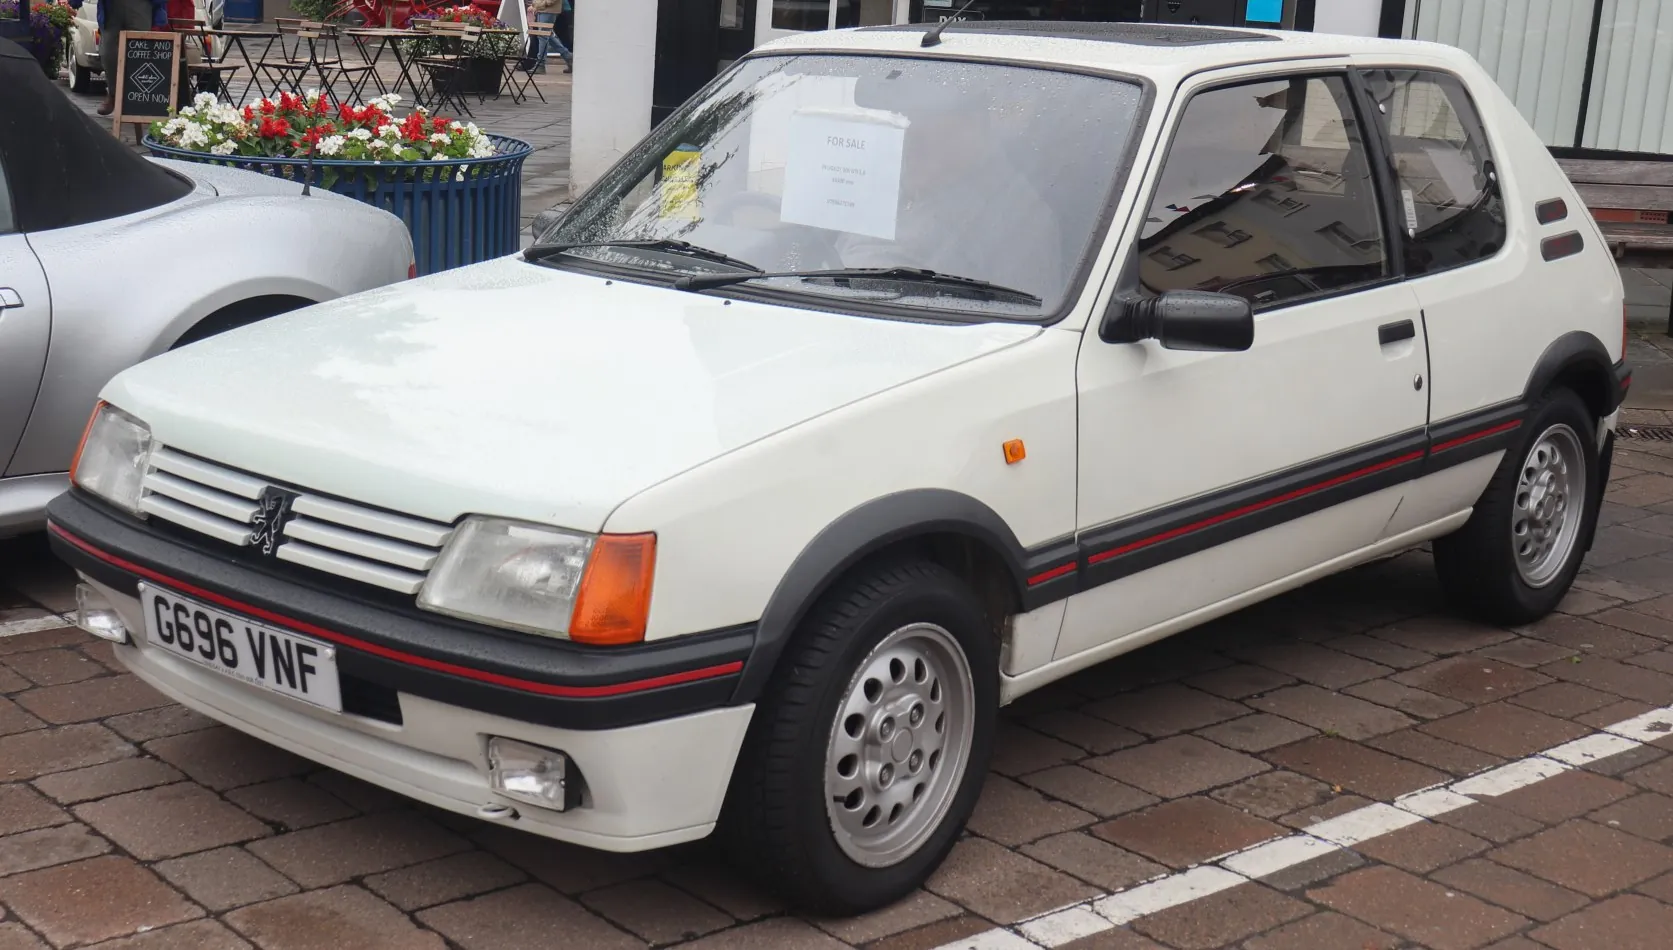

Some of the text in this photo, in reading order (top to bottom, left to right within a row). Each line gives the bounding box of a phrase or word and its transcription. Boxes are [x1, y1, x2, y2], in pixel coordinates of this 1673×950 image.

[129, 40, 171, 51] CAKE AND
[127, 50, 172, 60] COFFEE SHOP
[127, 91, 169, 104] OPEN NOW
[826, 135, 866, 150] FOR SALE
[154, 595, 318, 694] G696 VNF
